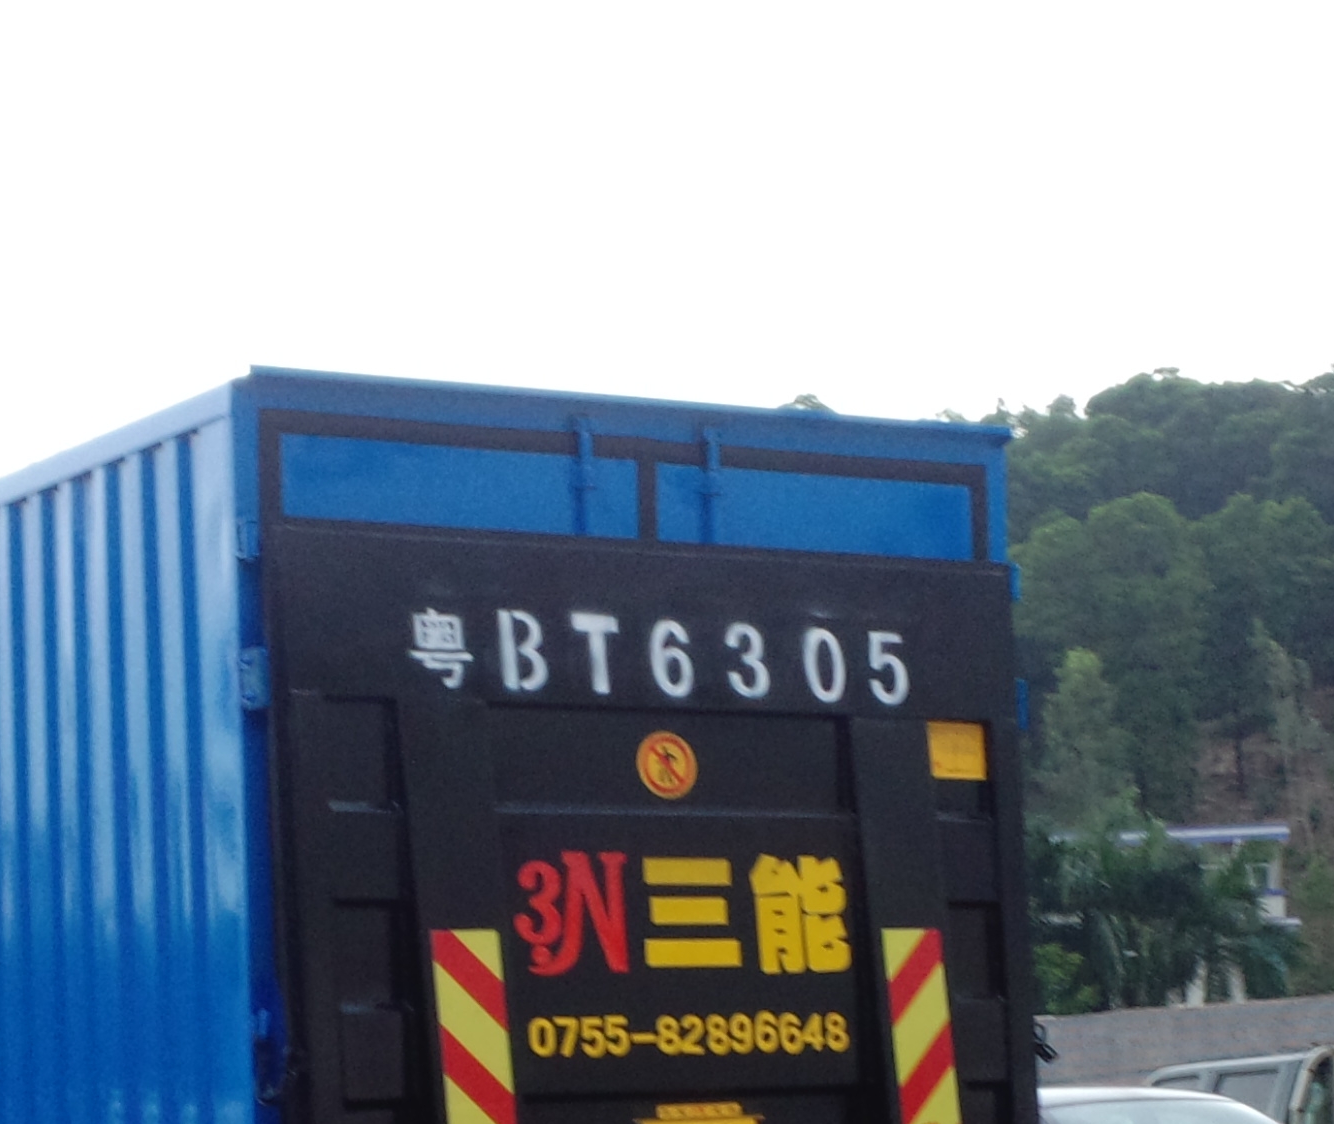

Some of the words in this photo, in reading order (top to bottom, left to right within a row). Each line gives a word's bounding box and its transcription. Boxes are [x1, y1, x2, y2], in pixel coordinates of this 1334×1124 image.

[408, 608, 910, 705] 粤BT6305
[642, 853, 853, 976] 三能
[527, 1009, 851, 1058] 0755-82896648
